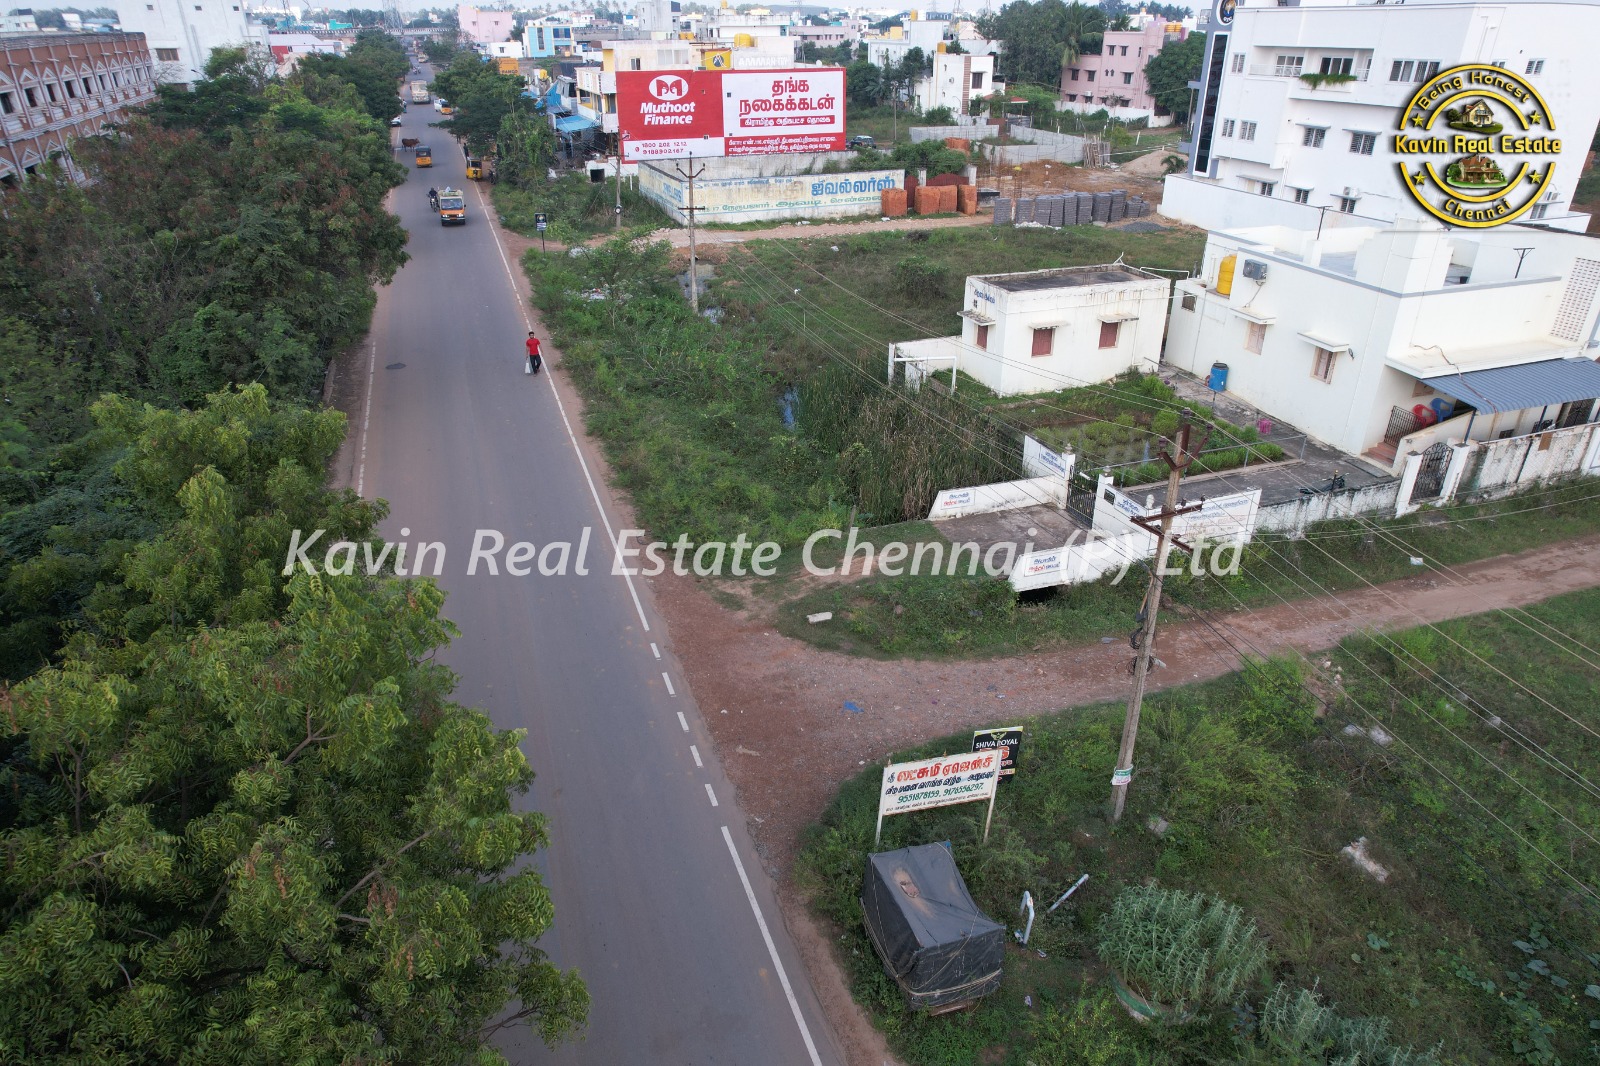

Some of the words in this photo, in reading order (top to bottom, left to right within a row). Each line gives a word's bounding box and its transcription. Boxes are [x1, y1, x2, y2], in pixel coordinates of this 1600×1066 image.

[772, 76, 810, 97] தங்க
[640, 101, 696, 114] Muthoot
[739, 93, 835, 117] நகைக்கடன்
[644, 114, 693, 125] Finance
[975, 740, 996, 749] SHIVA
